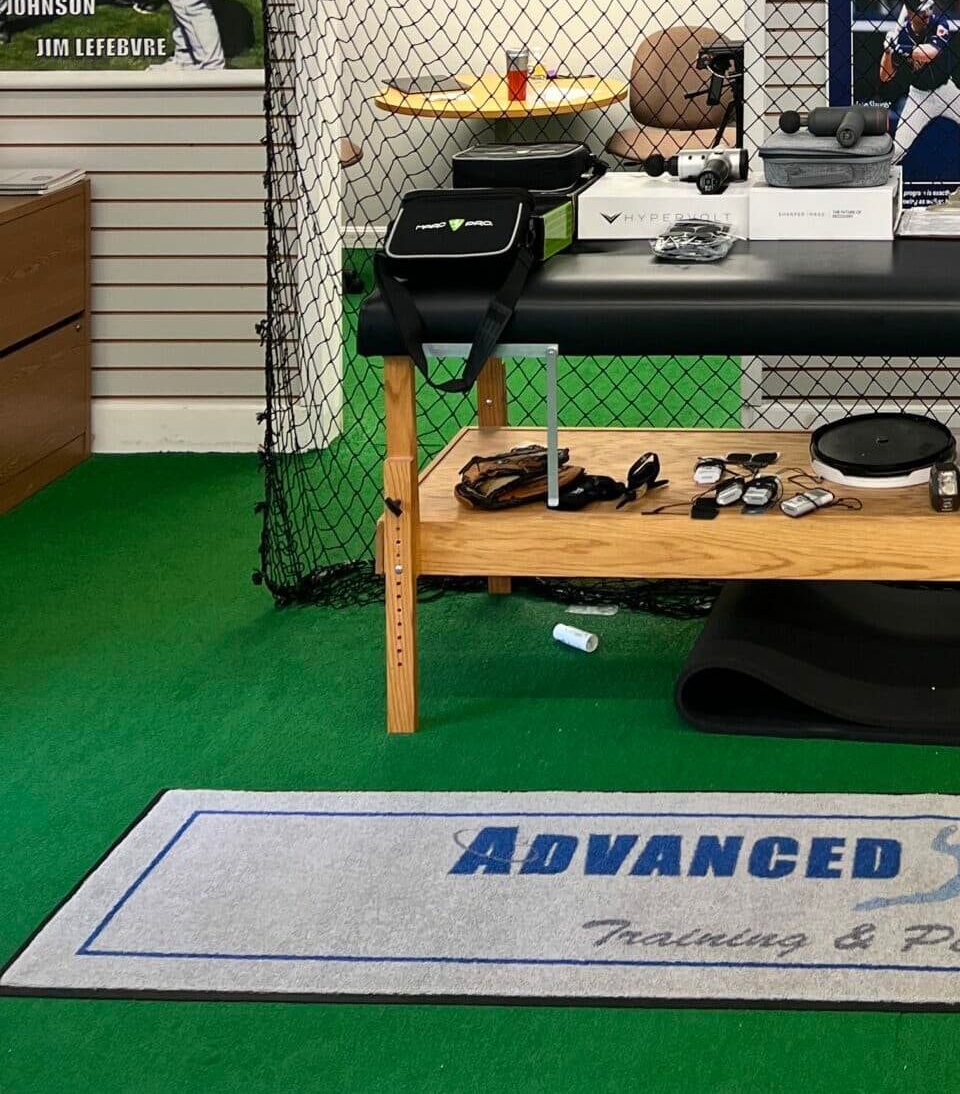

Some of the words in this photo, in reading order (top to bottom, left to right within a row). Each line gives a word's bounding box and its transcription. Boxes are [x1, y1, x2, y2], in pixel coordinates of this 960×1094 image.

[37, 38, 70, 57] JIM
[75, 37, 167, 57] LEFEBVRE
[624, 212, 733, 224] HYPERVOLT
[448, 826, 902, 879] ADVANCED
[583, 919, 806, 954] Training
[834, 923, 870, 950] &
